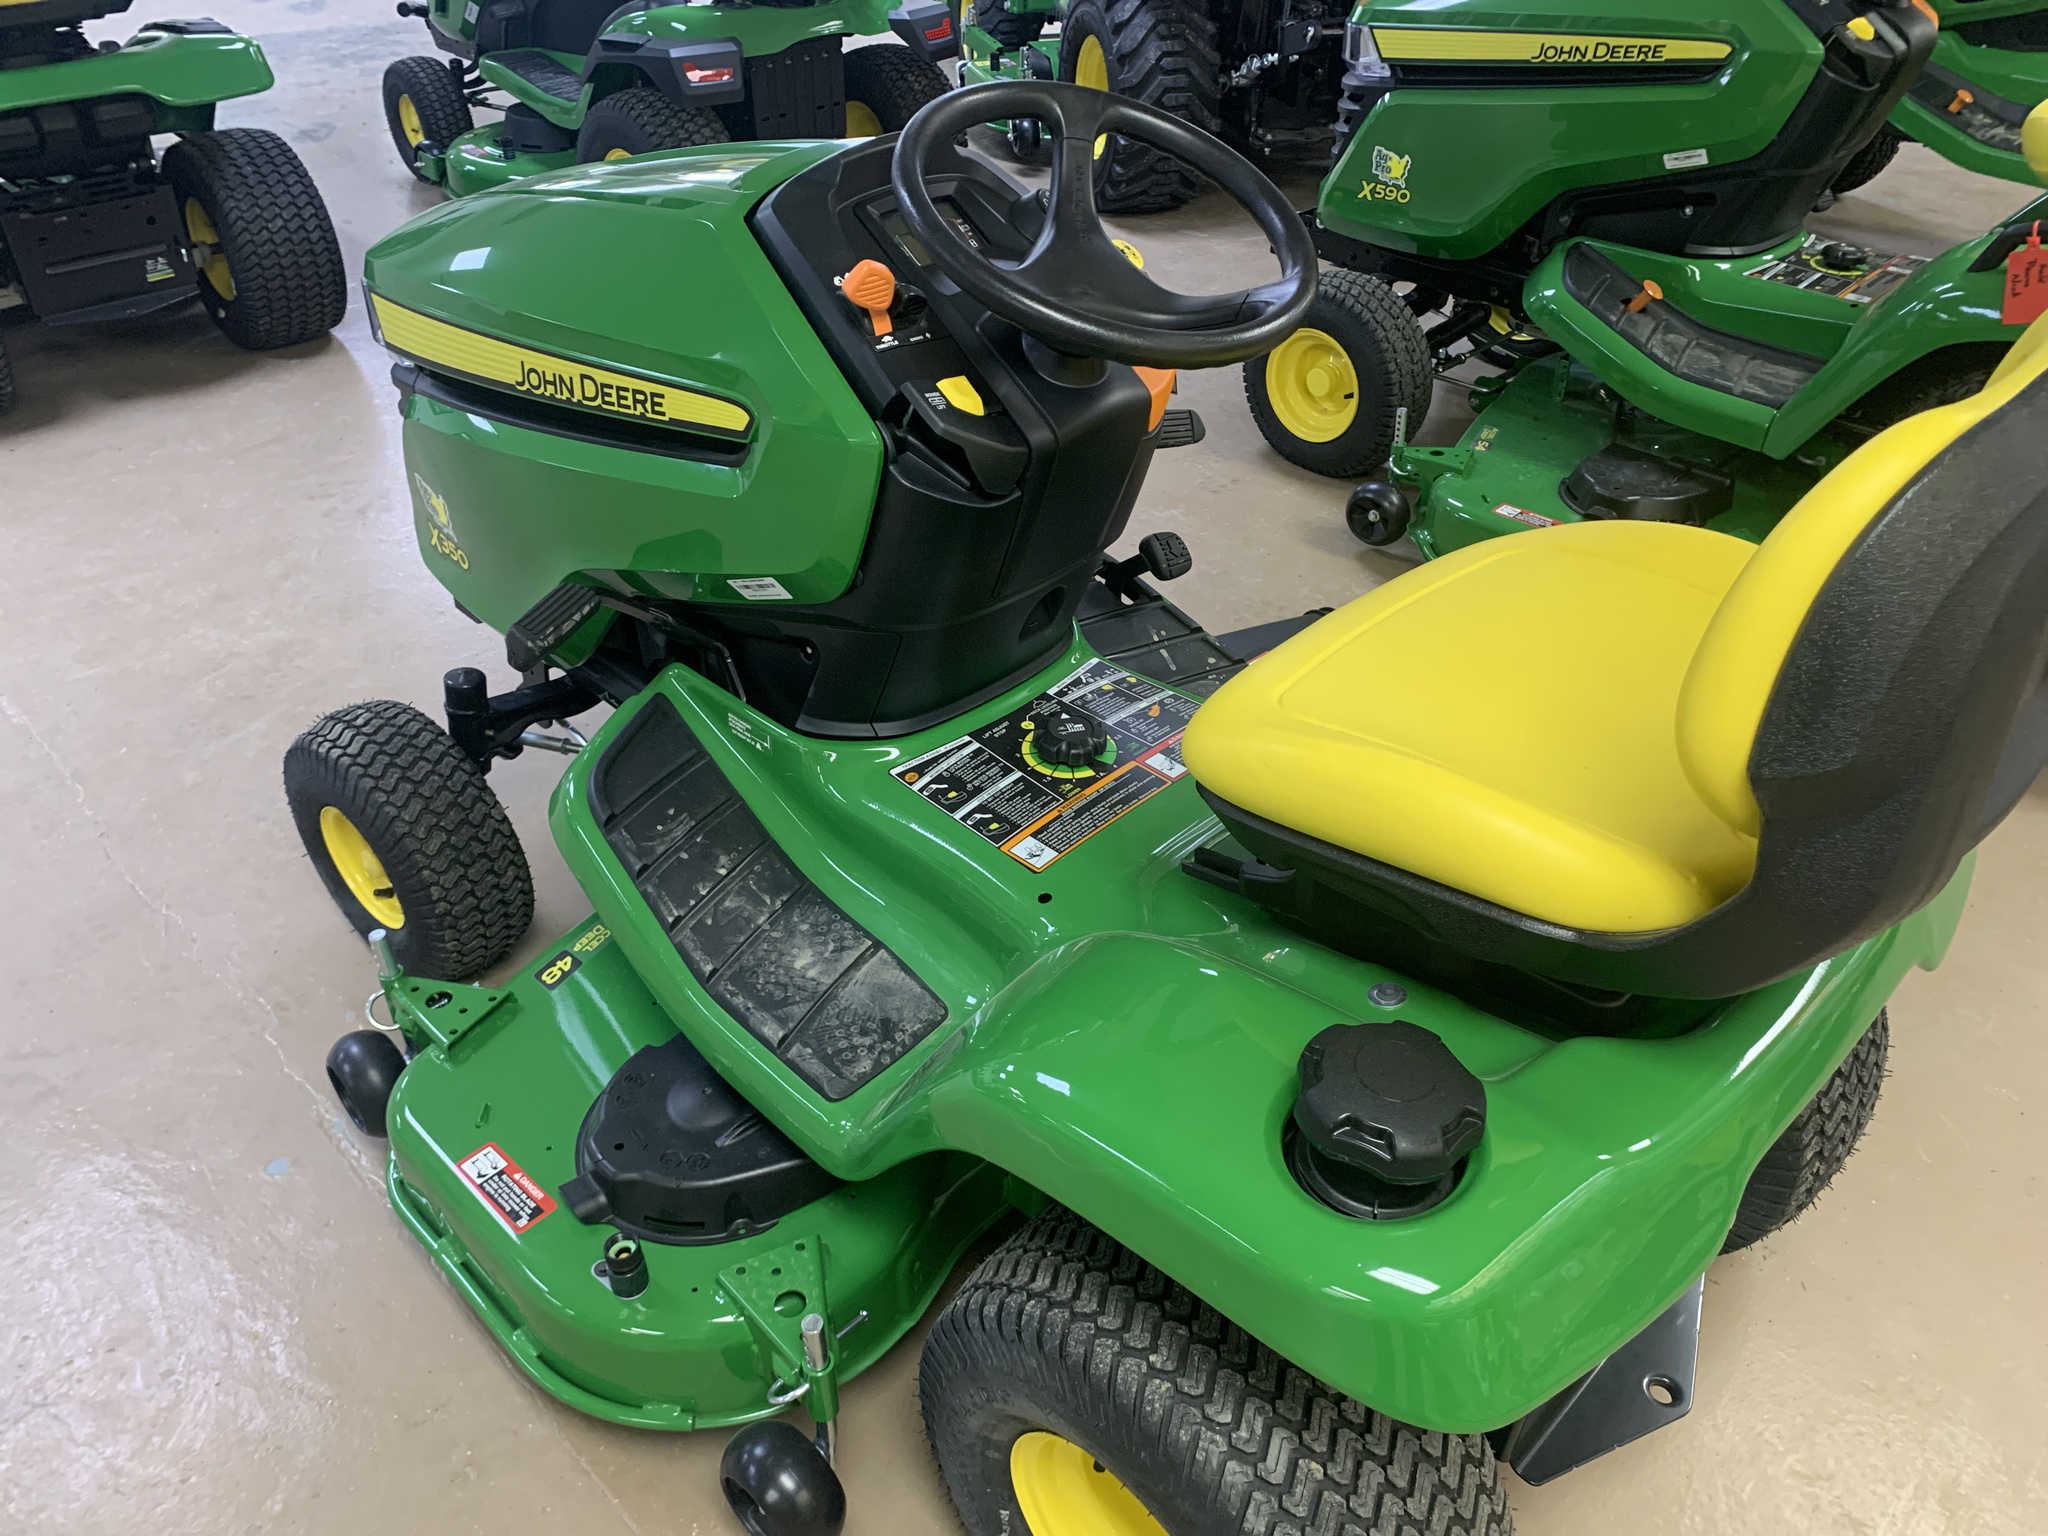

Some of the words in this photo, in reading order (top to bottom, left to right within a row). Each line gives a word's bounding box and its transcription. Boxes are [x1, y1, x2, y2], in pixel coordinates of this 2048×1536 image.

[1531, 43, 1588, 60] JOHN
[1592, 42, 1666, 60] DEERE
[1375, 161, 1392, 174] Pro
[1357, 180, 1411, 204] X590
[515, 360, 575, 399] JOHN
[580, 373, 667, 417] DEERE
[1475, 440, 1489, 451] 54
[428, 521, 469, 570] X350
[573, 924, 605, 952] DEEP
[582, 929, 611, 952] CCEL
[541, 955, 572, 985] 48
[520, 1176, 545, 1200] DANGER
